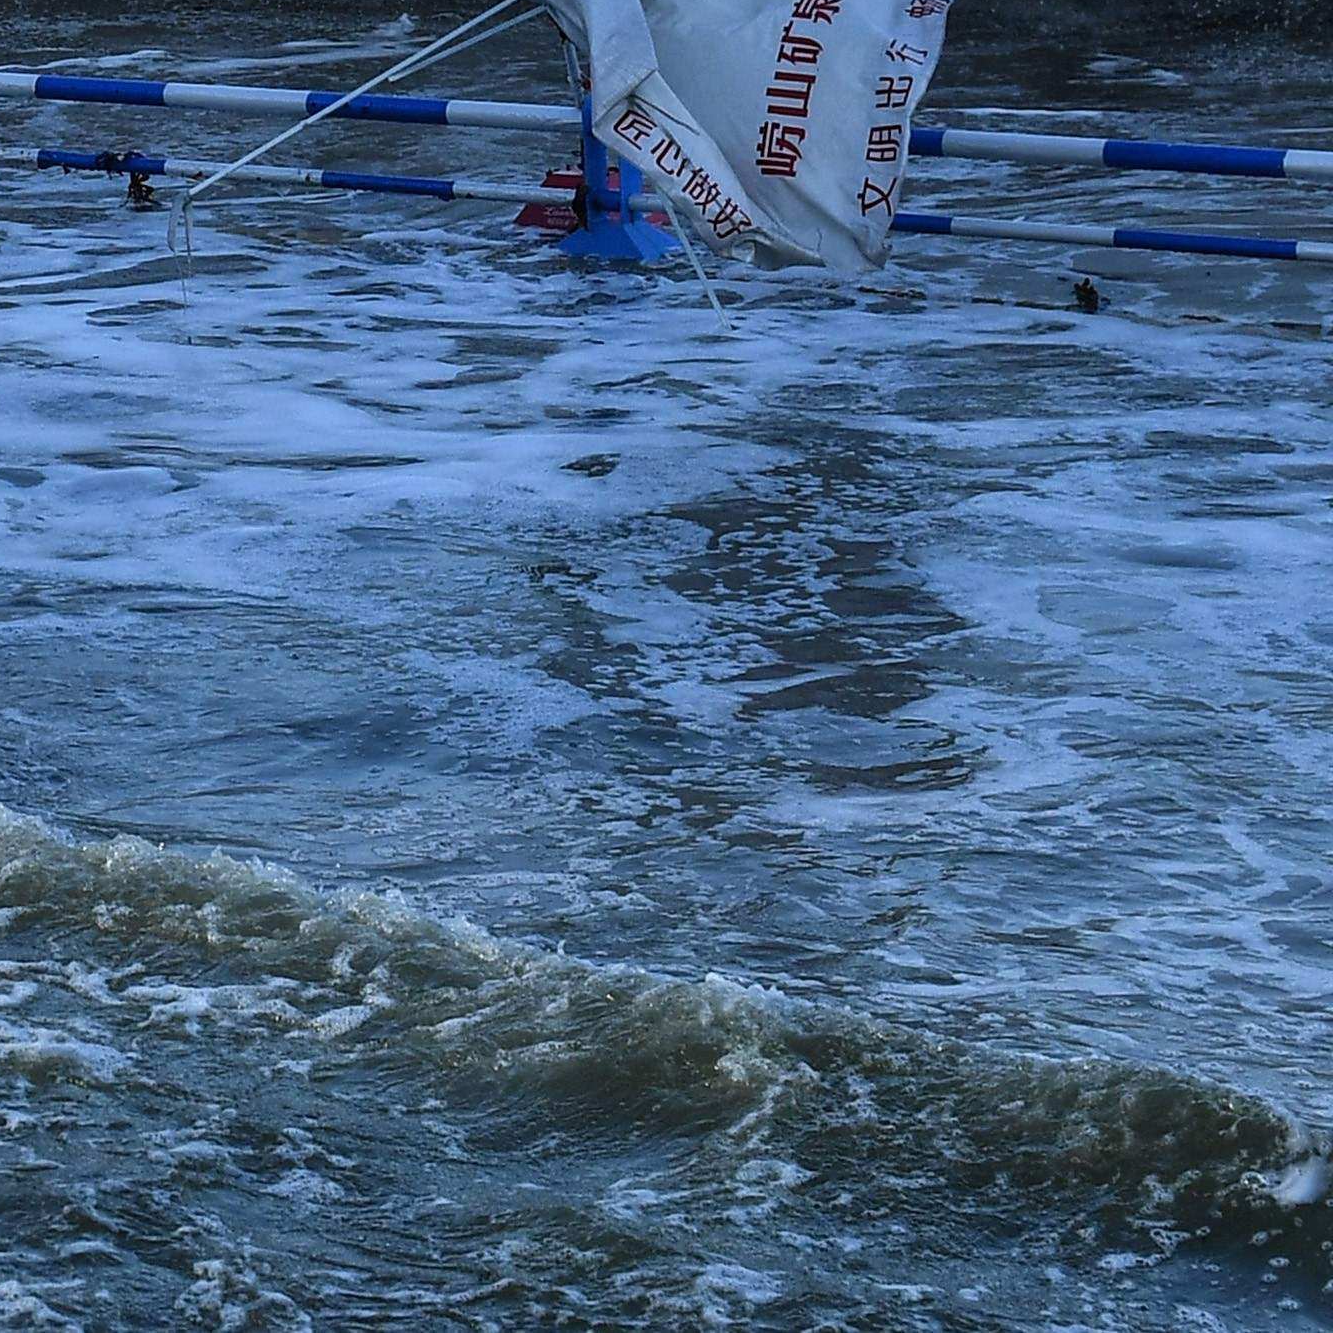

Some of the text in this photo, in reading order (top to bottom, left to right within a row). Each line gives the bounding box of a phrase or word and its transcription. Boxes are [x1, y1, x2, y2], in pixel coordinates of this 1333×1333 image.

[612, 108, 753, 240] 匠心做好
[856, 38, 930, 218] 文明出行
